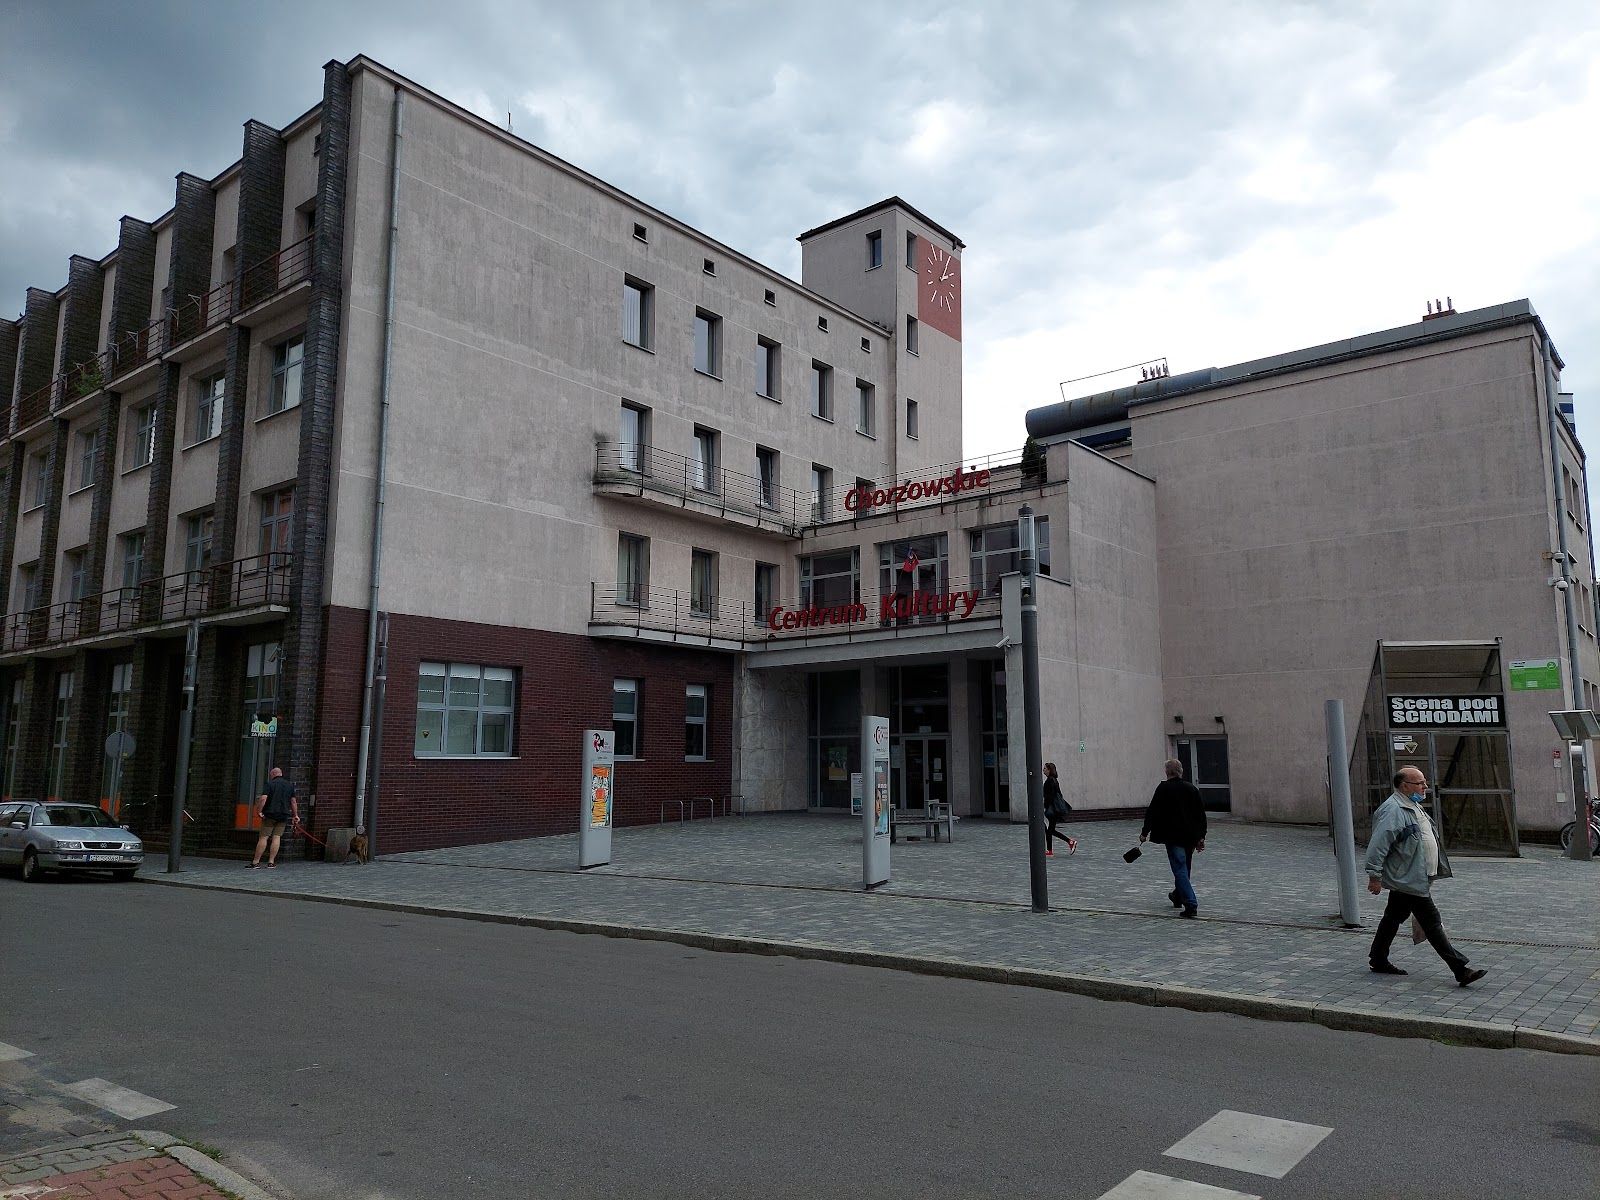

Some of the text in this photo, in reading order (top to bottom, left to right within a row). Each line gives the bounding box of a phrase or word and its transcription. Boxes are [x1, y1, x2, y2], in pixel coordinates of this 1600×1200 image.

[768, 588, 979, 631] Centrum Kultury
[1391, 696, 1498, 711] Scena pod
[1392, 710, 1499, 723] SCHODAMI
[252, 724, 276, 732] KINO
